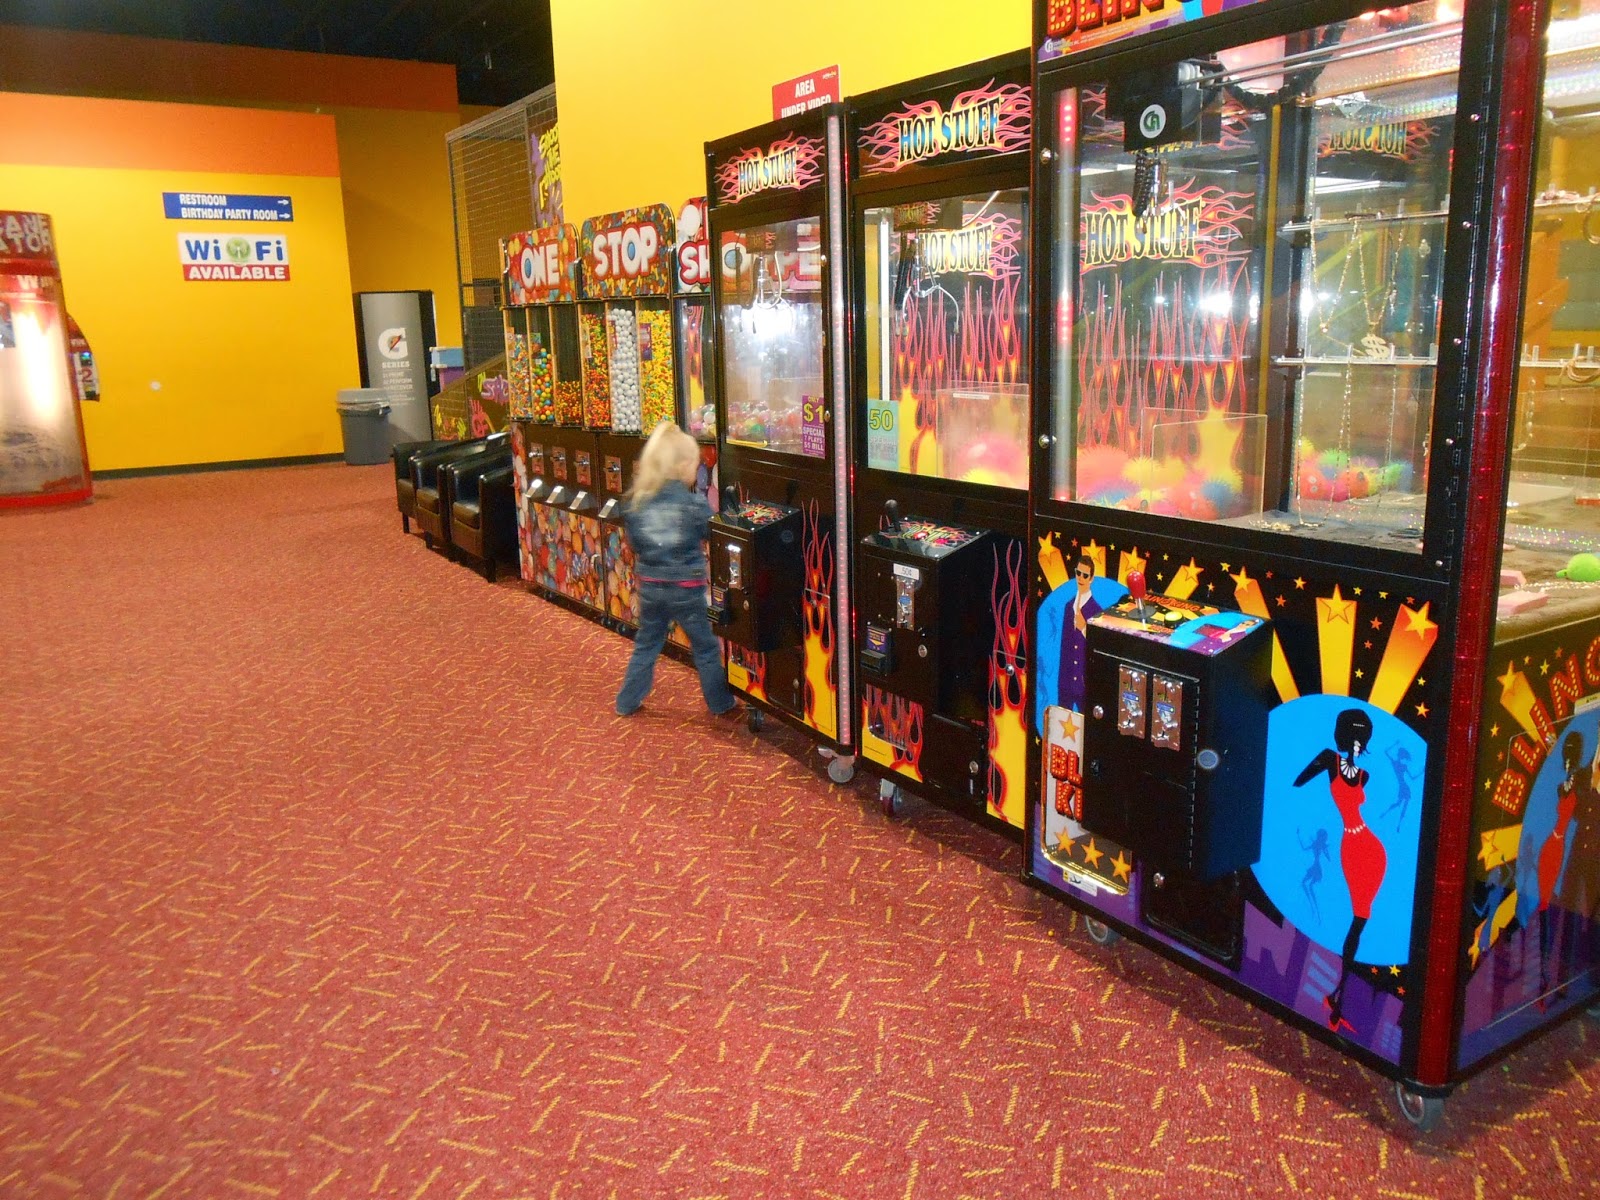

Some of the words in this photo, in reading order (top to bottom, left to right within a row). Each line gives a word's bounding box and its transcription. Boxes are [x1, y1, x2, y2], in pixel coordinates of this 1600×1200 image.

[795, 78, 815, 98] AREA
[781, 101, 806, 118] UNDER
[807, 94, 831, 110] VIDEO
[899, 116, 936, 162] HOT
[940, 96, 1000, 151] STUFF
[738, 160, 760, 195] HOT
[762, 146, 797, 188] STUFF
[179, 194, 227, 206] RESTROOM
[181, 208, 223, 219] BIRTHDAY
[225, 209, 252, 219] PARTY
[253, 210, 278, 220] ROOM
[1085, 212, 1128, 265] HOT
[1132, 200, 1200, 259] STUFF
[185, 239, 221, 261] Wi
[256, 240, 284, 261] Fi
[593, 225, 658, 277] STOP
[950, 223, 993, 272] STUFF
[188, 266, 286, 280] AVAILABLE
[521, 243, 560, 289] ONE
[378, 328, 409, 360] G
[382, 361, 410, 369] SERIES
[868, 409, 894, 431] 50
[803, 427, 824, 438] SPECIAL
[1055, 779, 1084, 822] KI
